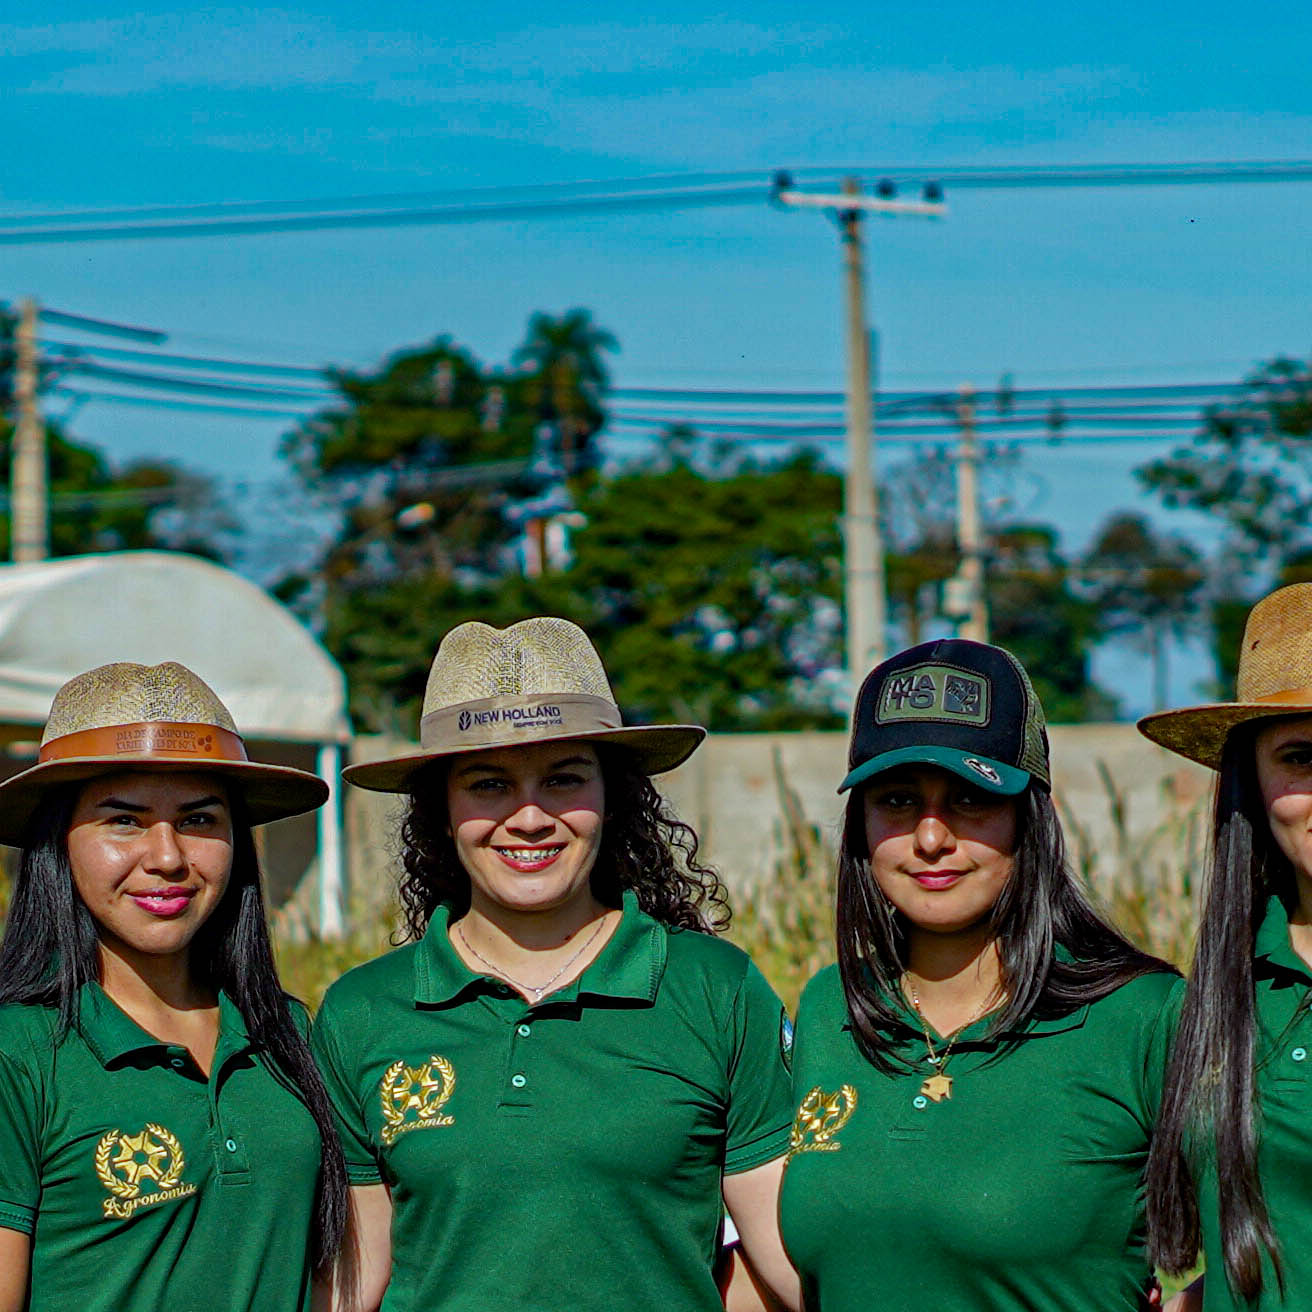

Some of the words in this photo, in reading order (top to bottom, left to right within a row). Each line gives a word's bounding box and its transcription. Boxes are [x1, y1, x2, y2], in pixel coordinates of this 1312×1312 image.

[474, 710, 500, 724] NEW
[502, 706, 561, 721] HOLLAND
[148, 727, 182, 738] AMPO
